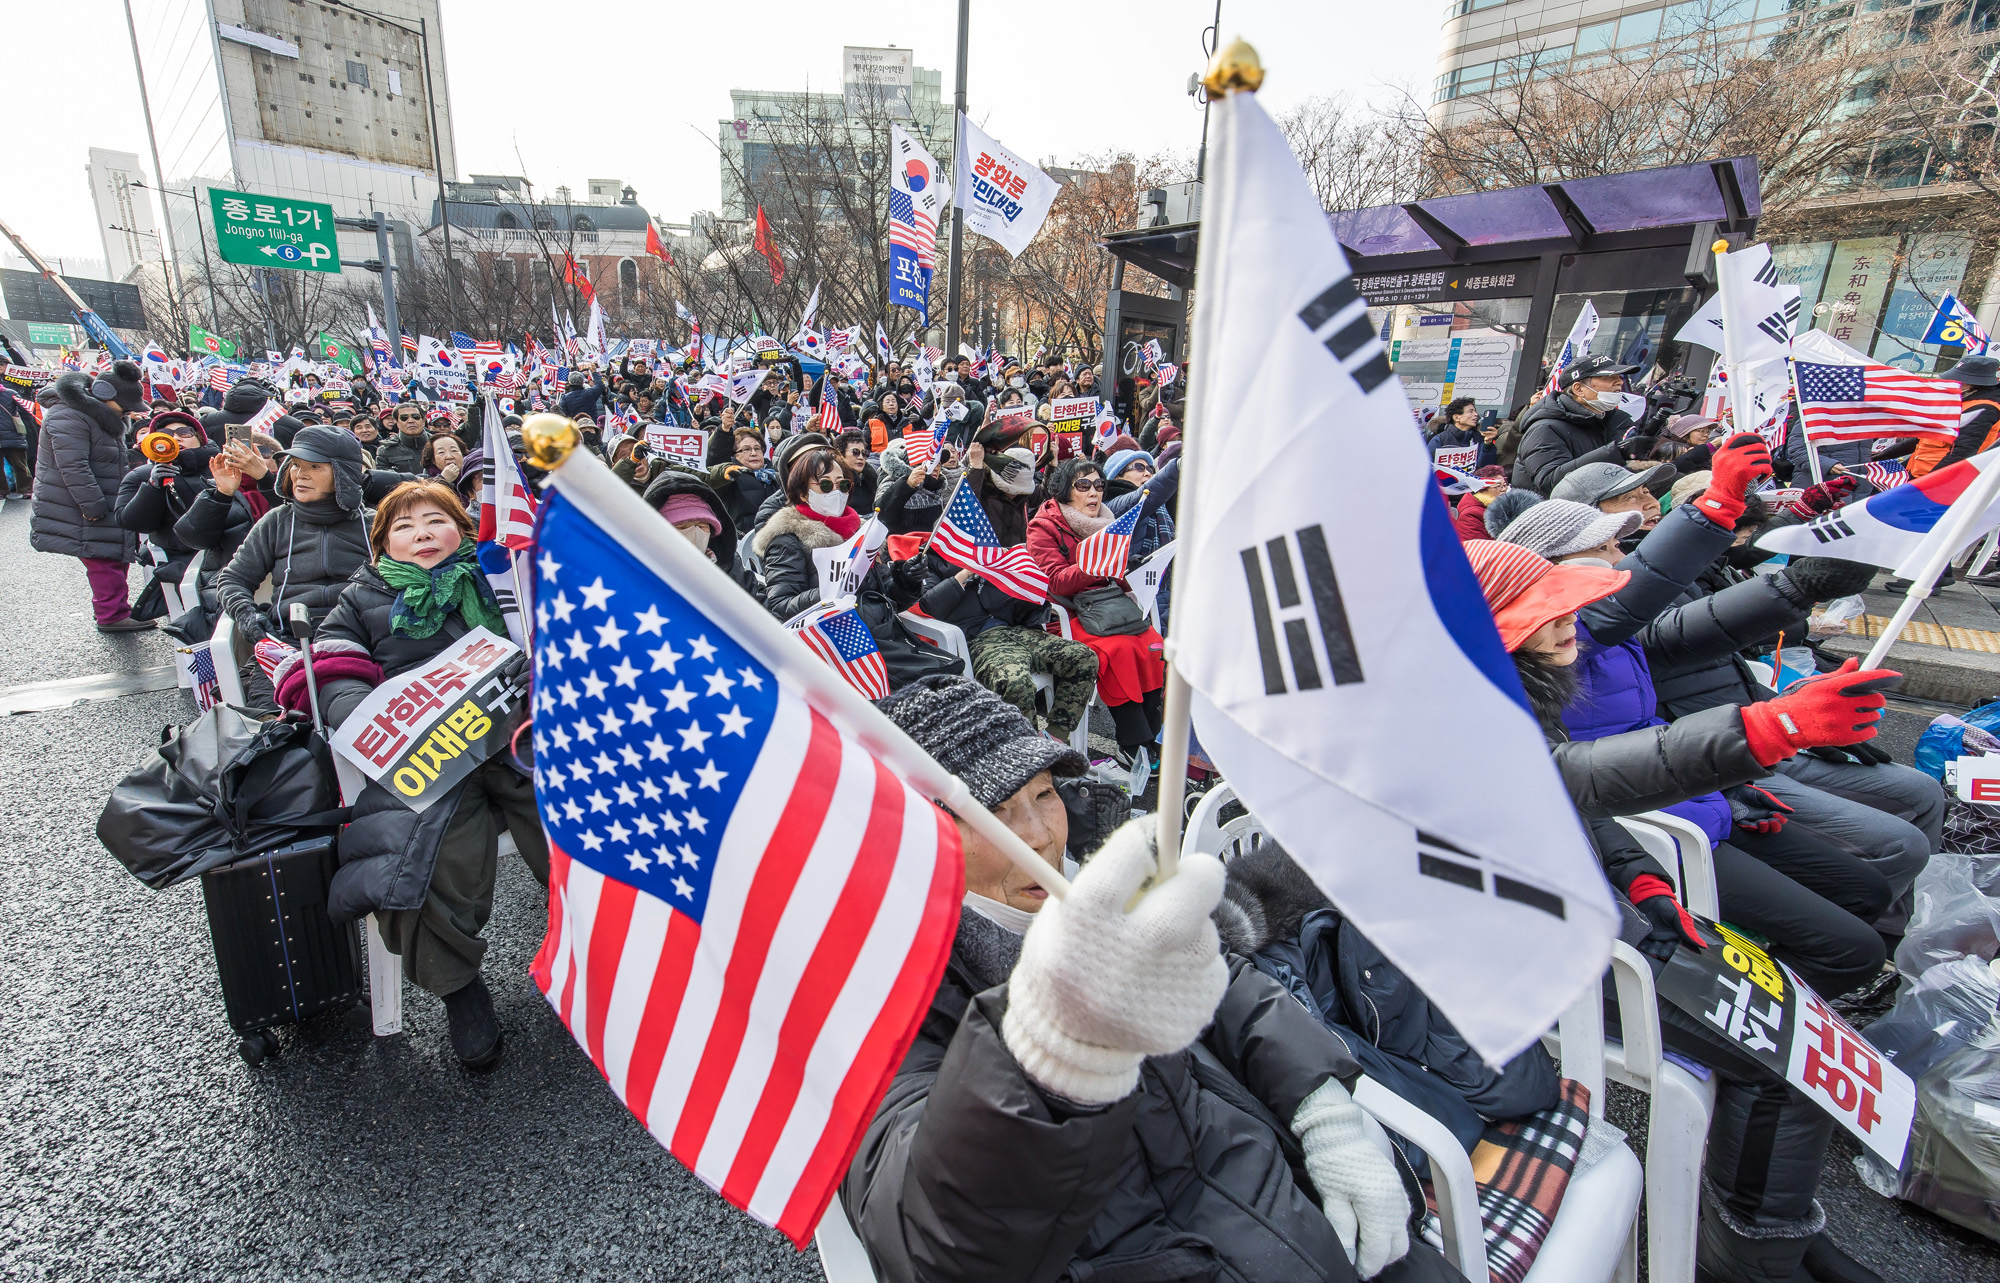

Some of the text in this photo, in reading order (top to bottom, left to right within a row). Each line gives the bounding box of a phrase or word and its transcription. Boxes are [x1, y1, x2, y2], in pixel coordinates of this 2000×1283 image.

[974, 152, 1028, 201] 광화문
[222, 197, 323, 231] 종로1가
[224, 222, 304, 244] Jongno 1(il)-ga
[284, 247, 295, 259] 6
[1464, 274, 1516, 289] 세종문화회관
[8, 368, 50, 379] 탄핵무효
[428, 369, 467, 379] FREEDOM
[439, 390, 470, 402] FREE
[352, 637, 508, 769] 탄핵무효
[393, 699, 493, 797] 이재명
[1704, 974, 1784, 1054] 구속
